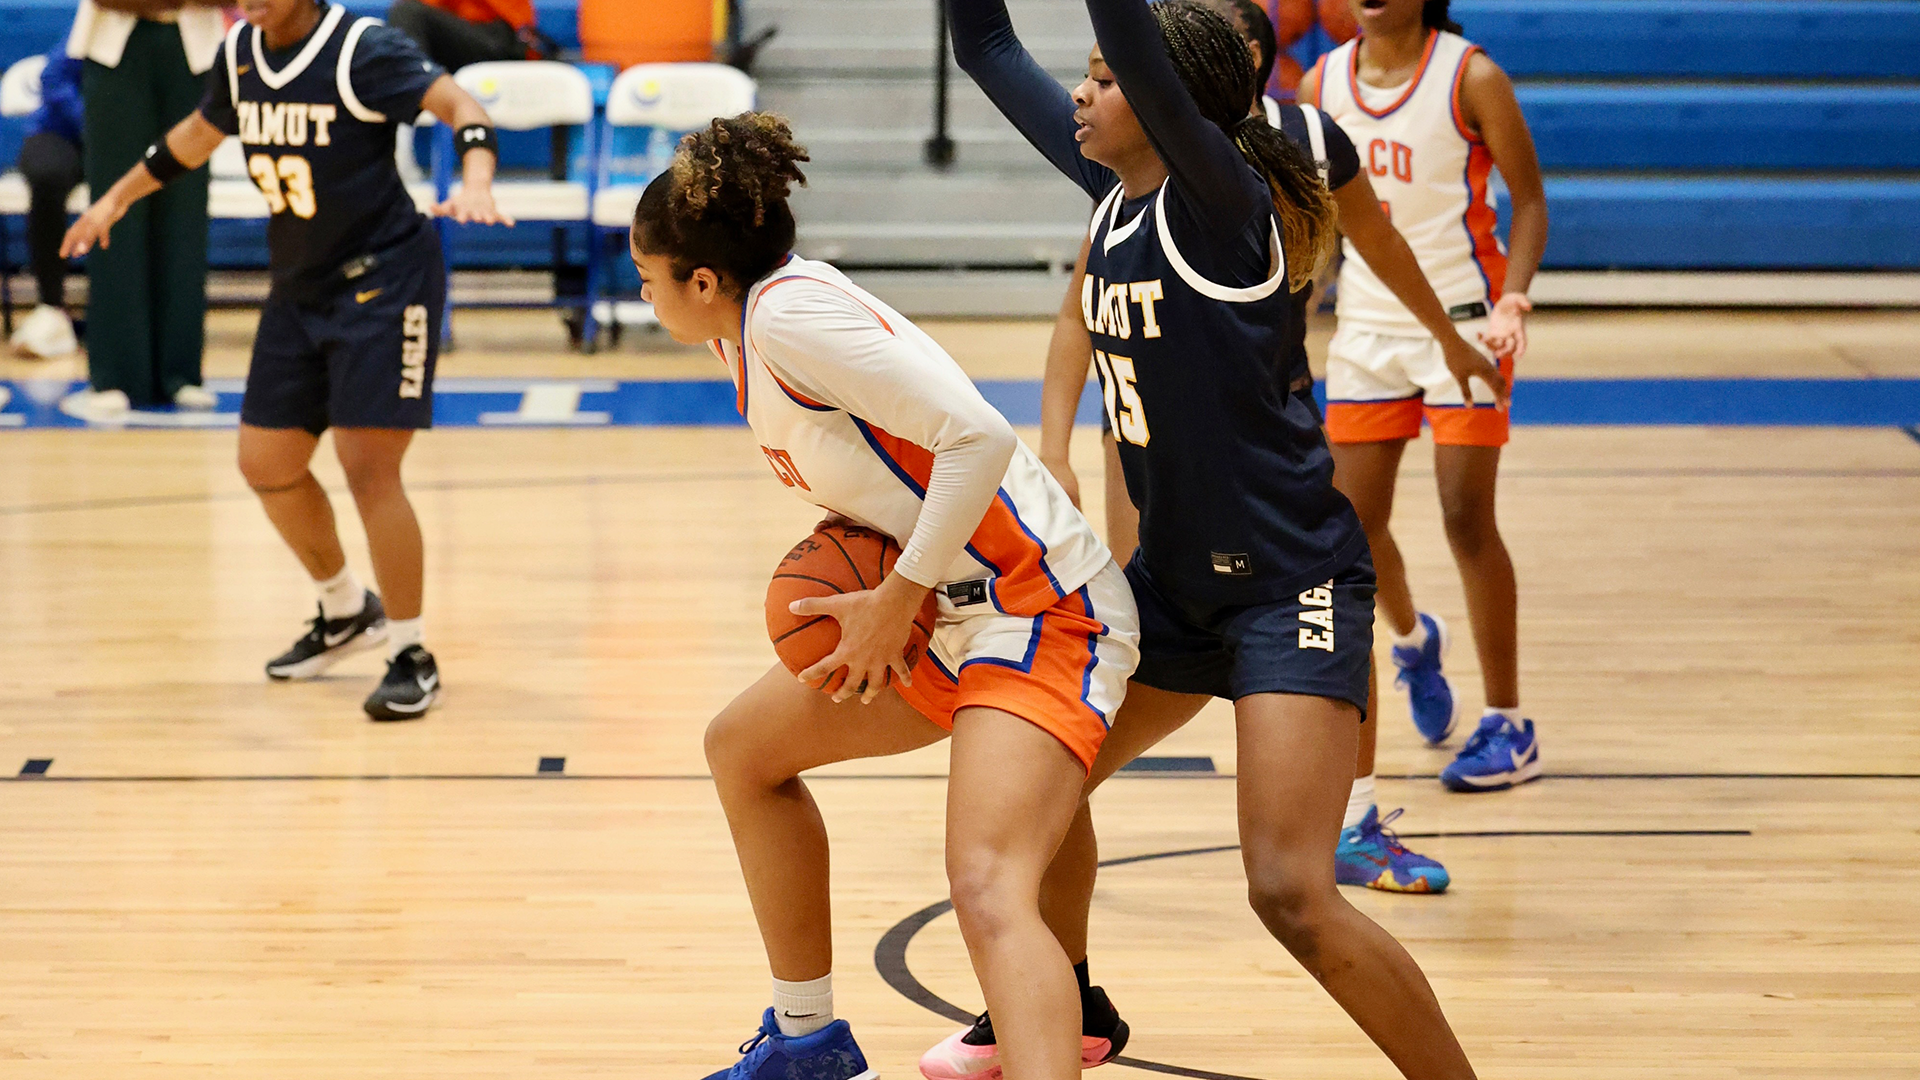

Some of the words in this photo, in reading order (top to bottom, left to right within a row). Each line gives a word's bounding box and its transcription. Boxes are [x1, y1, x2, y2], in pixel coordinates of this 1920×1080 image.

[1366, 138, 1412, 184] CU
[248, 153, 317, 219] 33
[1081, 273, 1164, 339] AMUT
[1095, 349, 1150, 447] 15
[760, 445, 811, 492] CU
[1235, 559, 1246, 569] M
[973, 586, 981, 597] M
